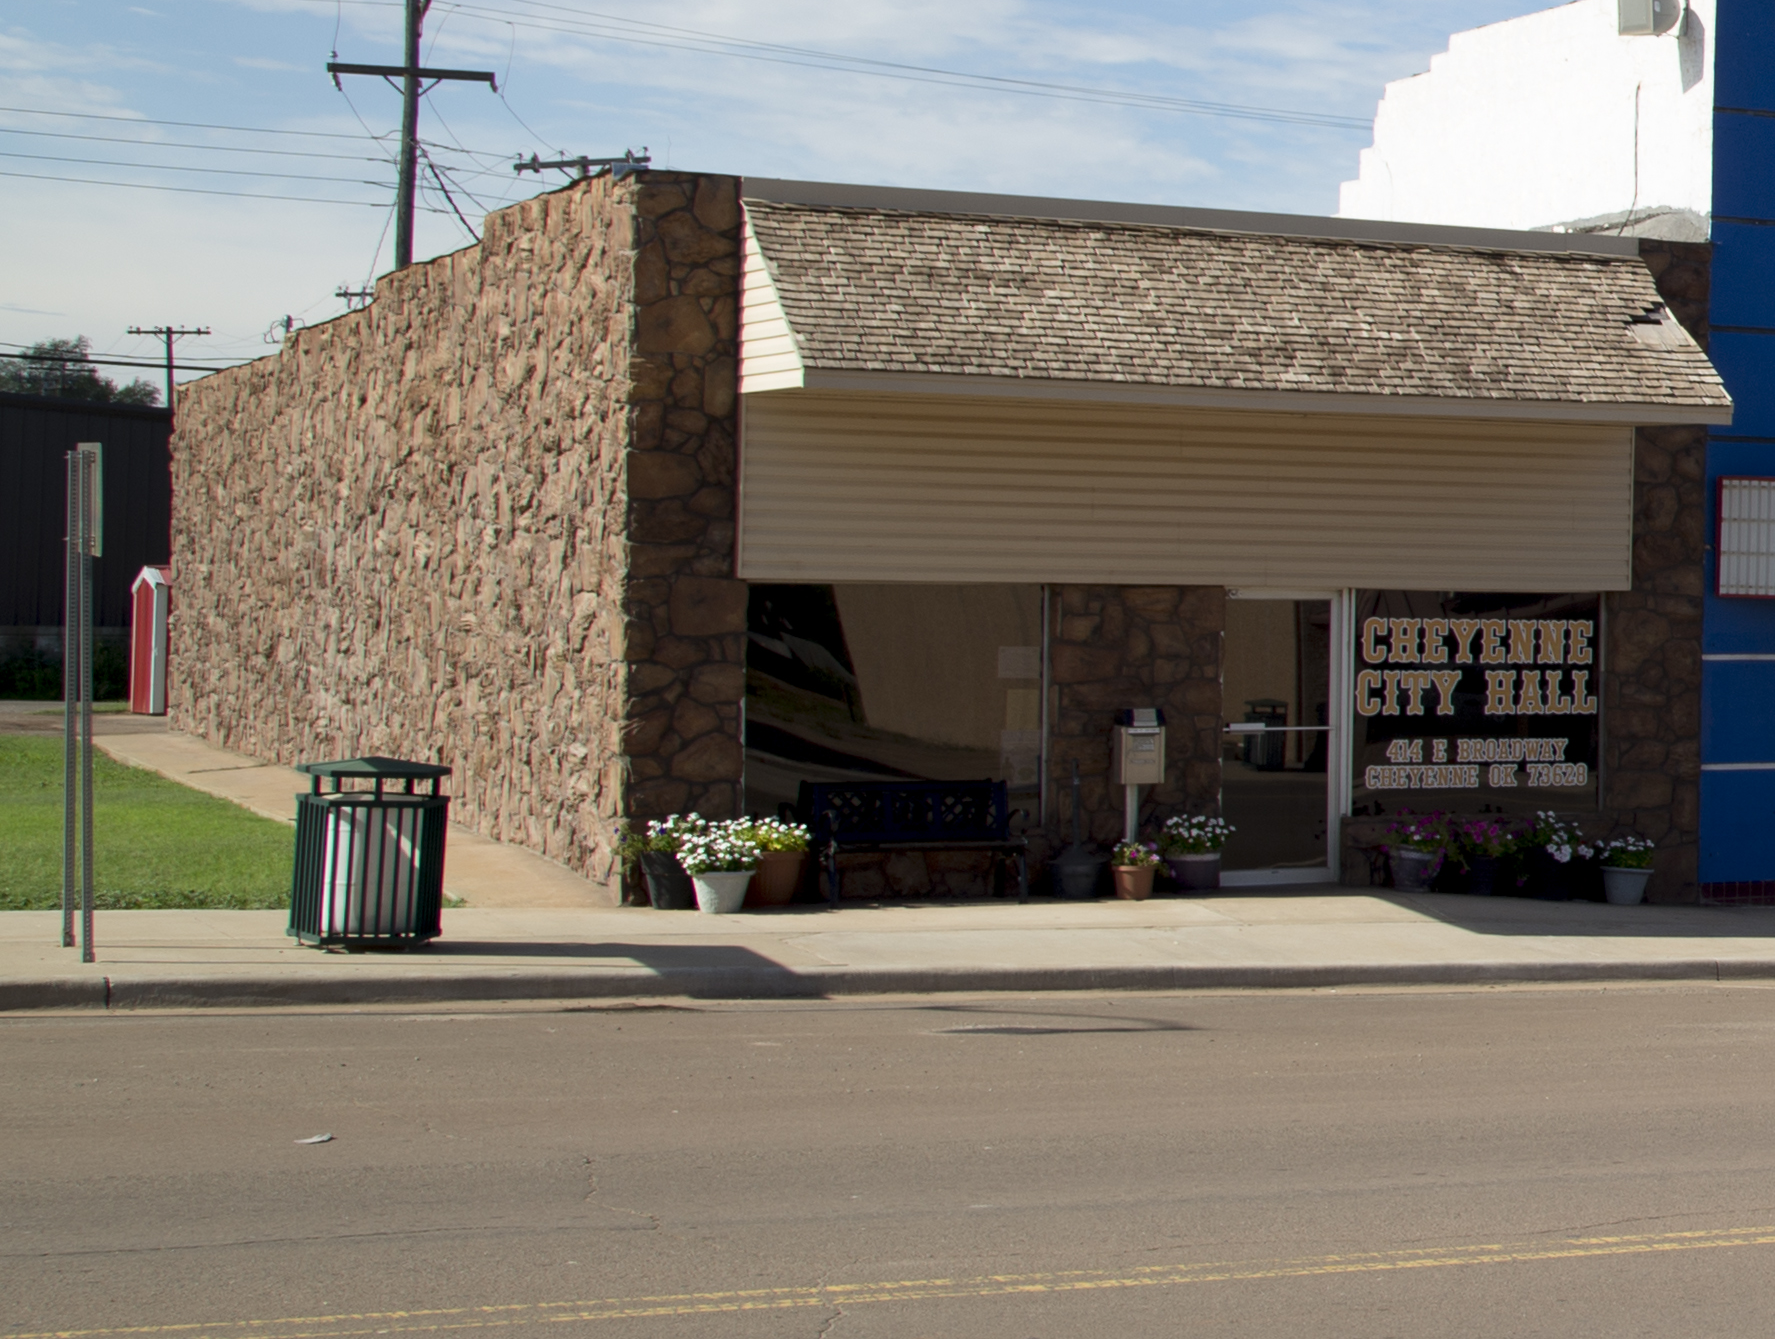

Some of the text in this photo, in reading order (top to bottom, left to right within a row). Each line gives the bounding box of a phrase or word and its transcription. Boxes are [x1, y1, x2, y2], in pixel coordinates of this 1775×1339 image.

[1362, 617, 1594, 664] CHEYENNE
[1356, 670, 1597, 716] CITY HALL
[1387, 738, 1568, 762] 414 E BROADWAY
[1366, 762, 1588, 789] CHEYENNE OK 73628
